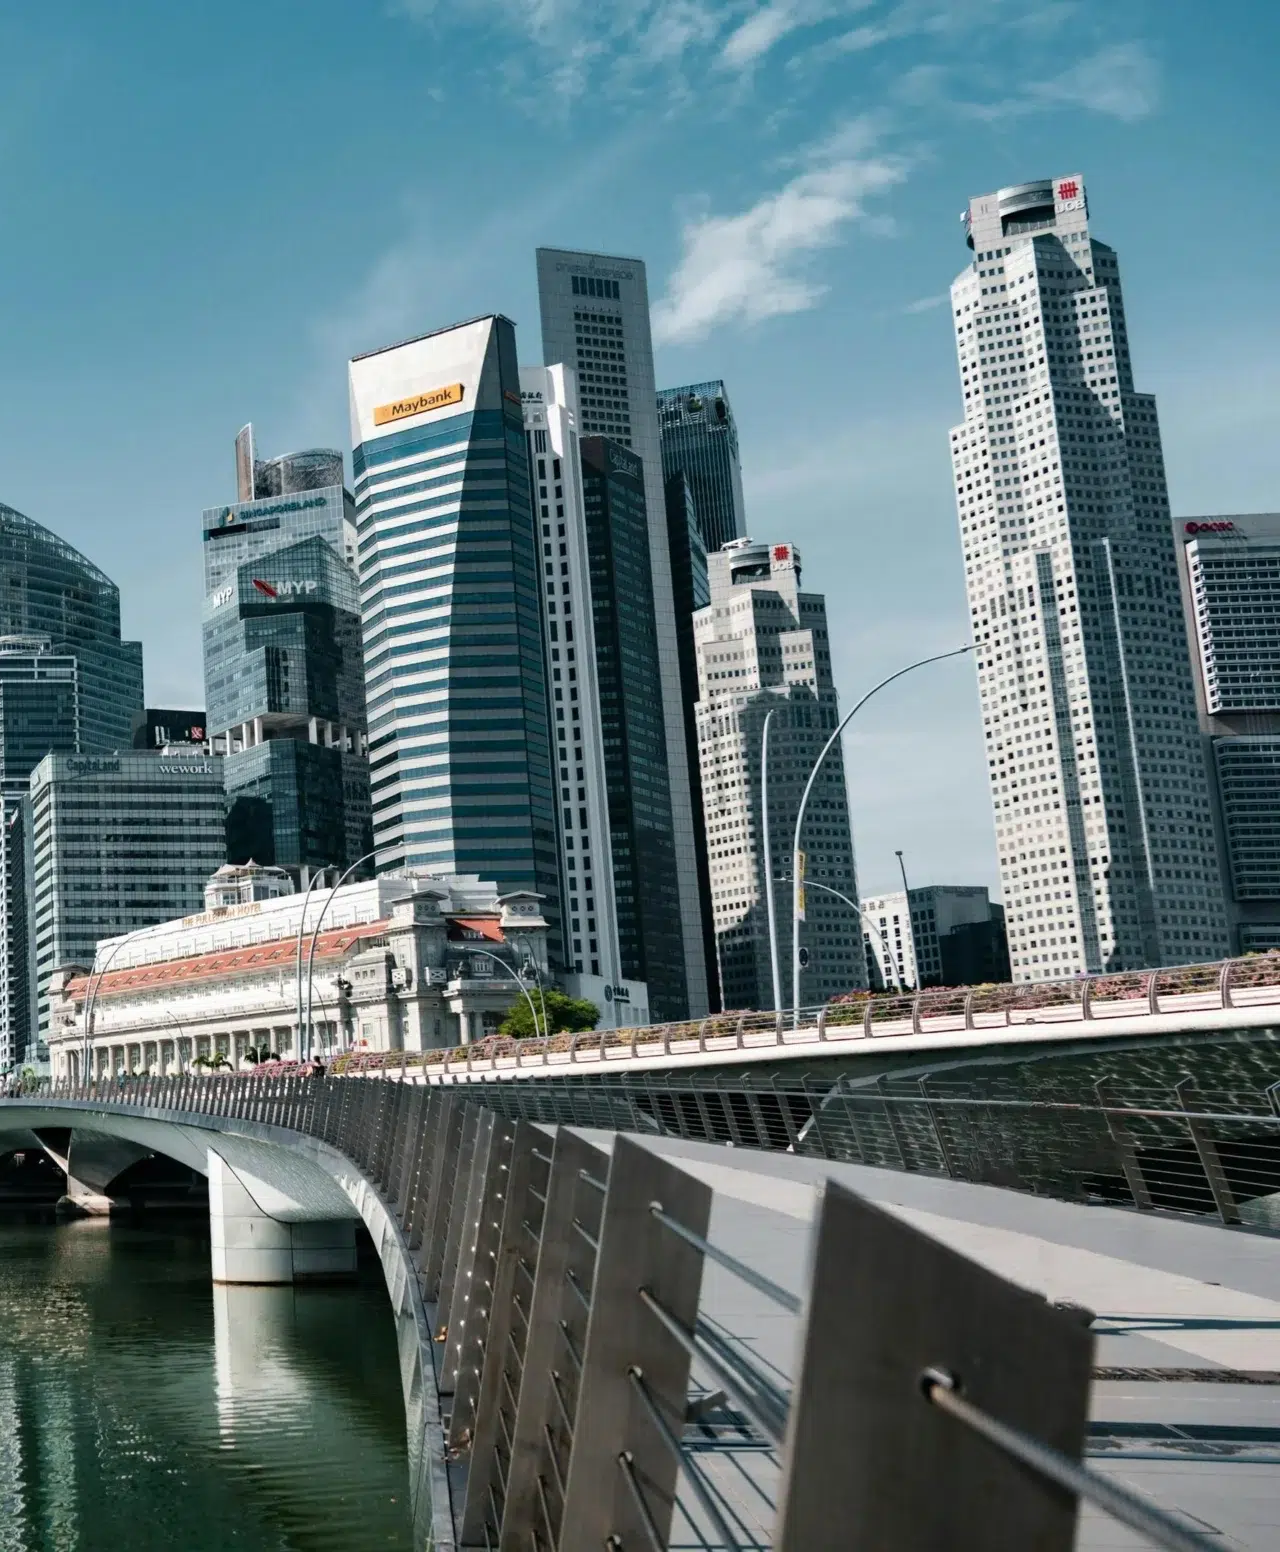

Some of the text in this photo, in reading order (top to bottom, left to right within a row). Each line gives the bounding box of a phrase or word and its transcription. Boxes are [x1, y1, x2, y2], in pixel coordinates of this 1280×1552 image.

[1055, 200, 1086, 214] UOB
[391, 389, 453, 416] Maybank
[277, 580, 318, 595] MYP
[213, 586, 234, 609] MYP
[66, 758, 120, 774] CapitaLand
[159, 761, 213, 774] wework
